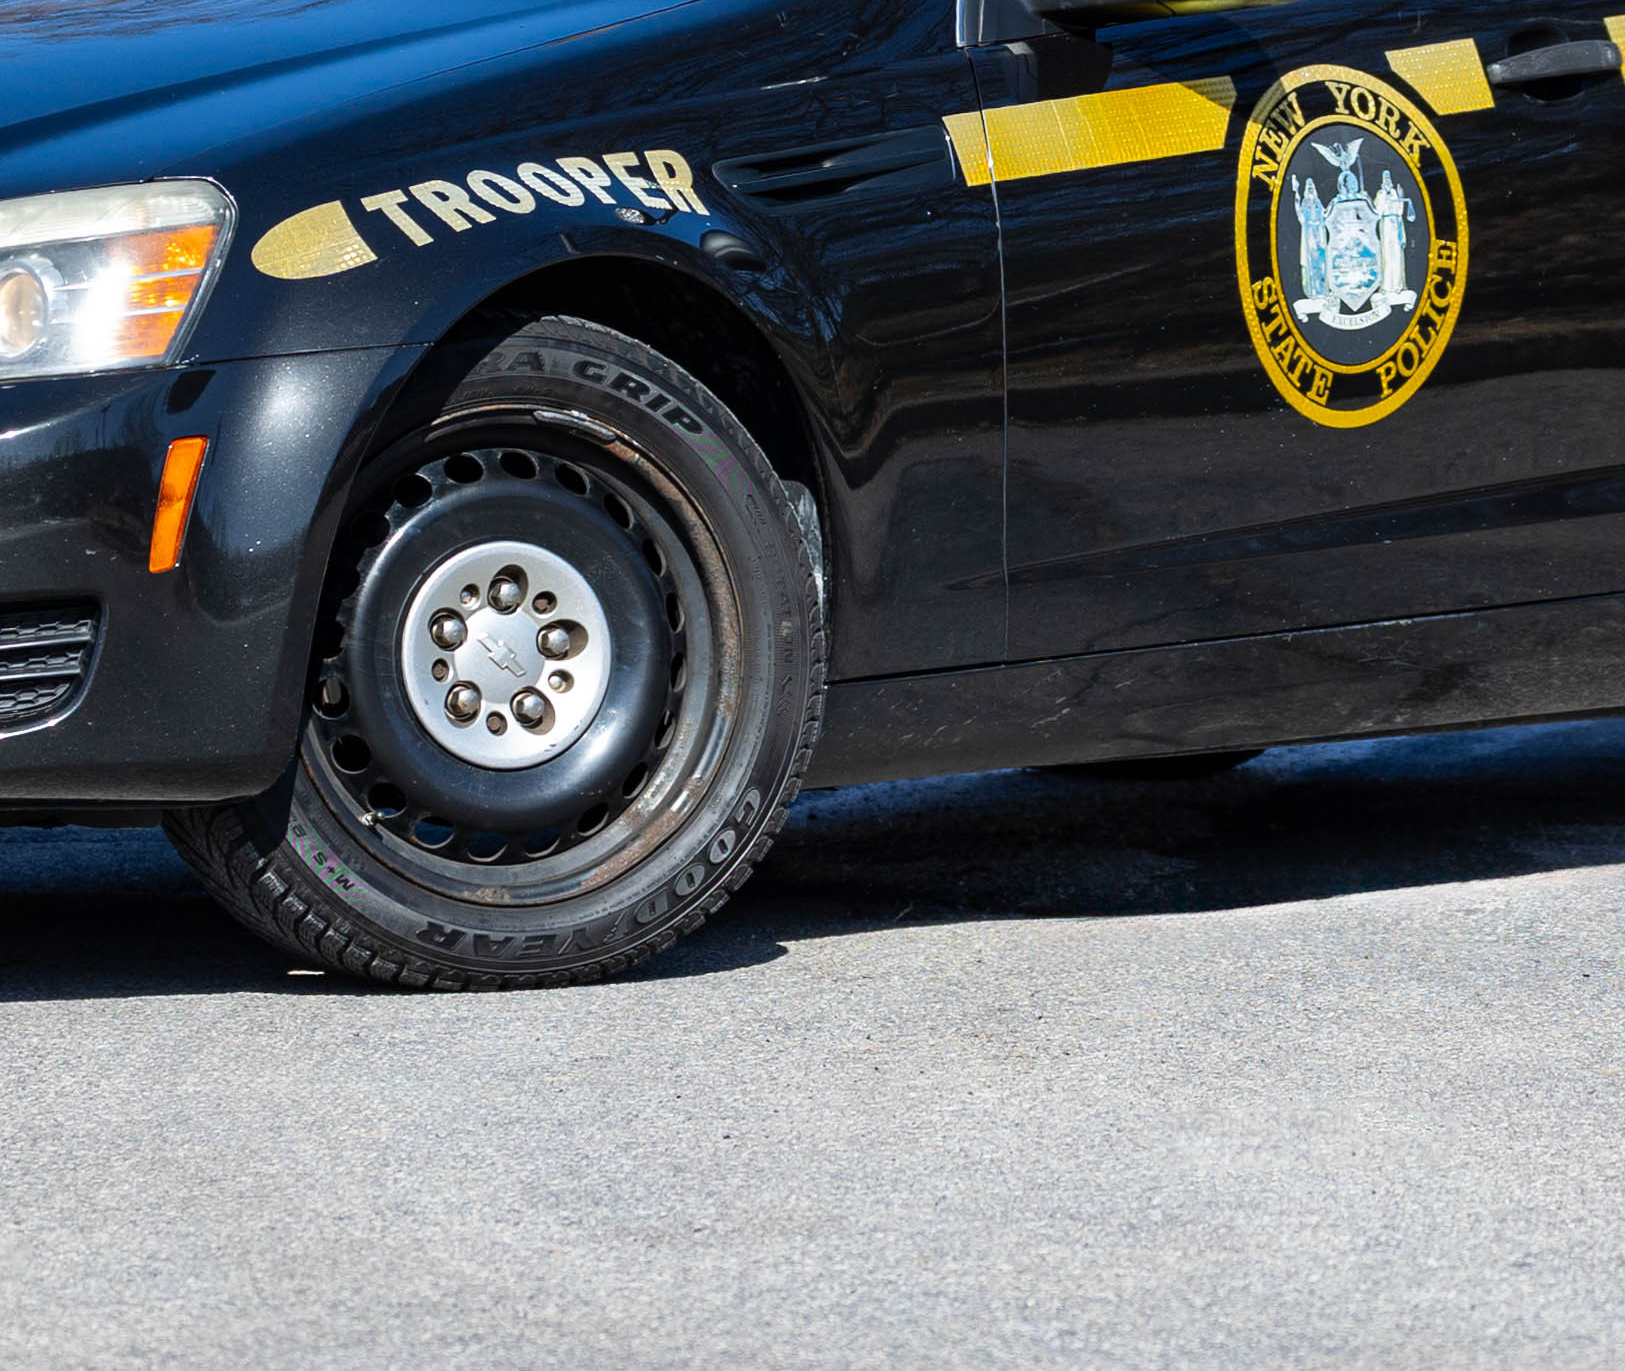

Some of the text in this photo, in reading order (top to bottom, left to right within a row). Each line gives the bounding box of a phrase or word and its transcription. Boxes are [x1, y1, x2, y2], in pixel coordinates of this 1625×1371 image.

[1252, 80, 1433, 191] NEW YORK
[360, 149, 711, 247] TROOPER
[1251, 238, 1457, 406] STATE POLICE
[571, 358, 704, 436] GRIP
